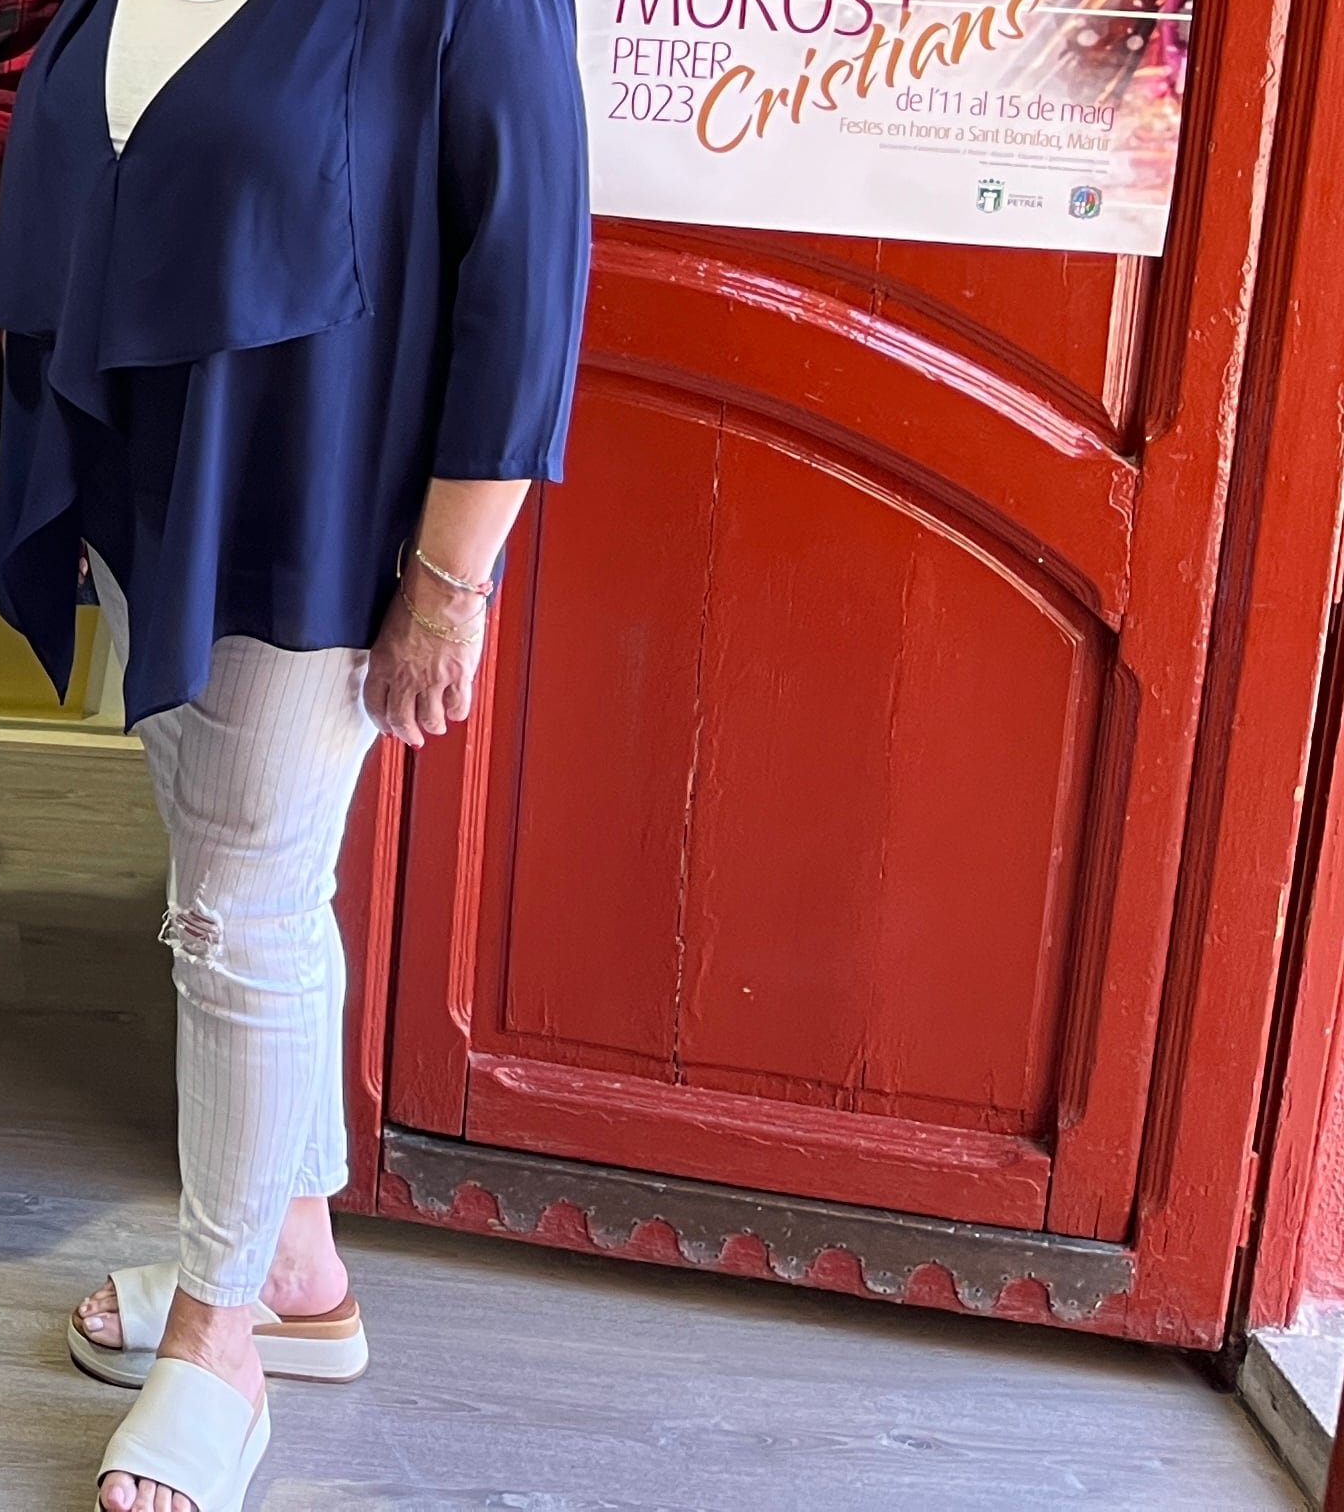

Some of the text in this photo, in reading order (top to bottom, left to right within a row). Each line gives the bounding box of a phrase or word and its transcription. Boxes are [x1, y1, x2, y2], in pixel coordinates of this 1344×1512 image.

[612, 36, 732, 80] PETRER
[607, 81, 695, 124] 2023
[896, 85, 923, 112] de
[969, 91, 988, 117] al
[996, 94, 1021, 119] 15
[1027, 94, 1055, 122] de
[1060, 103, 1115, 133] maig
[839, 117, 883, 136] Festes
[887, 123, 906, 137] en
[910, 120, 952, 140] honor
[955, 127, 965, 141] a
[968, 125, 1000, 144] Sant
